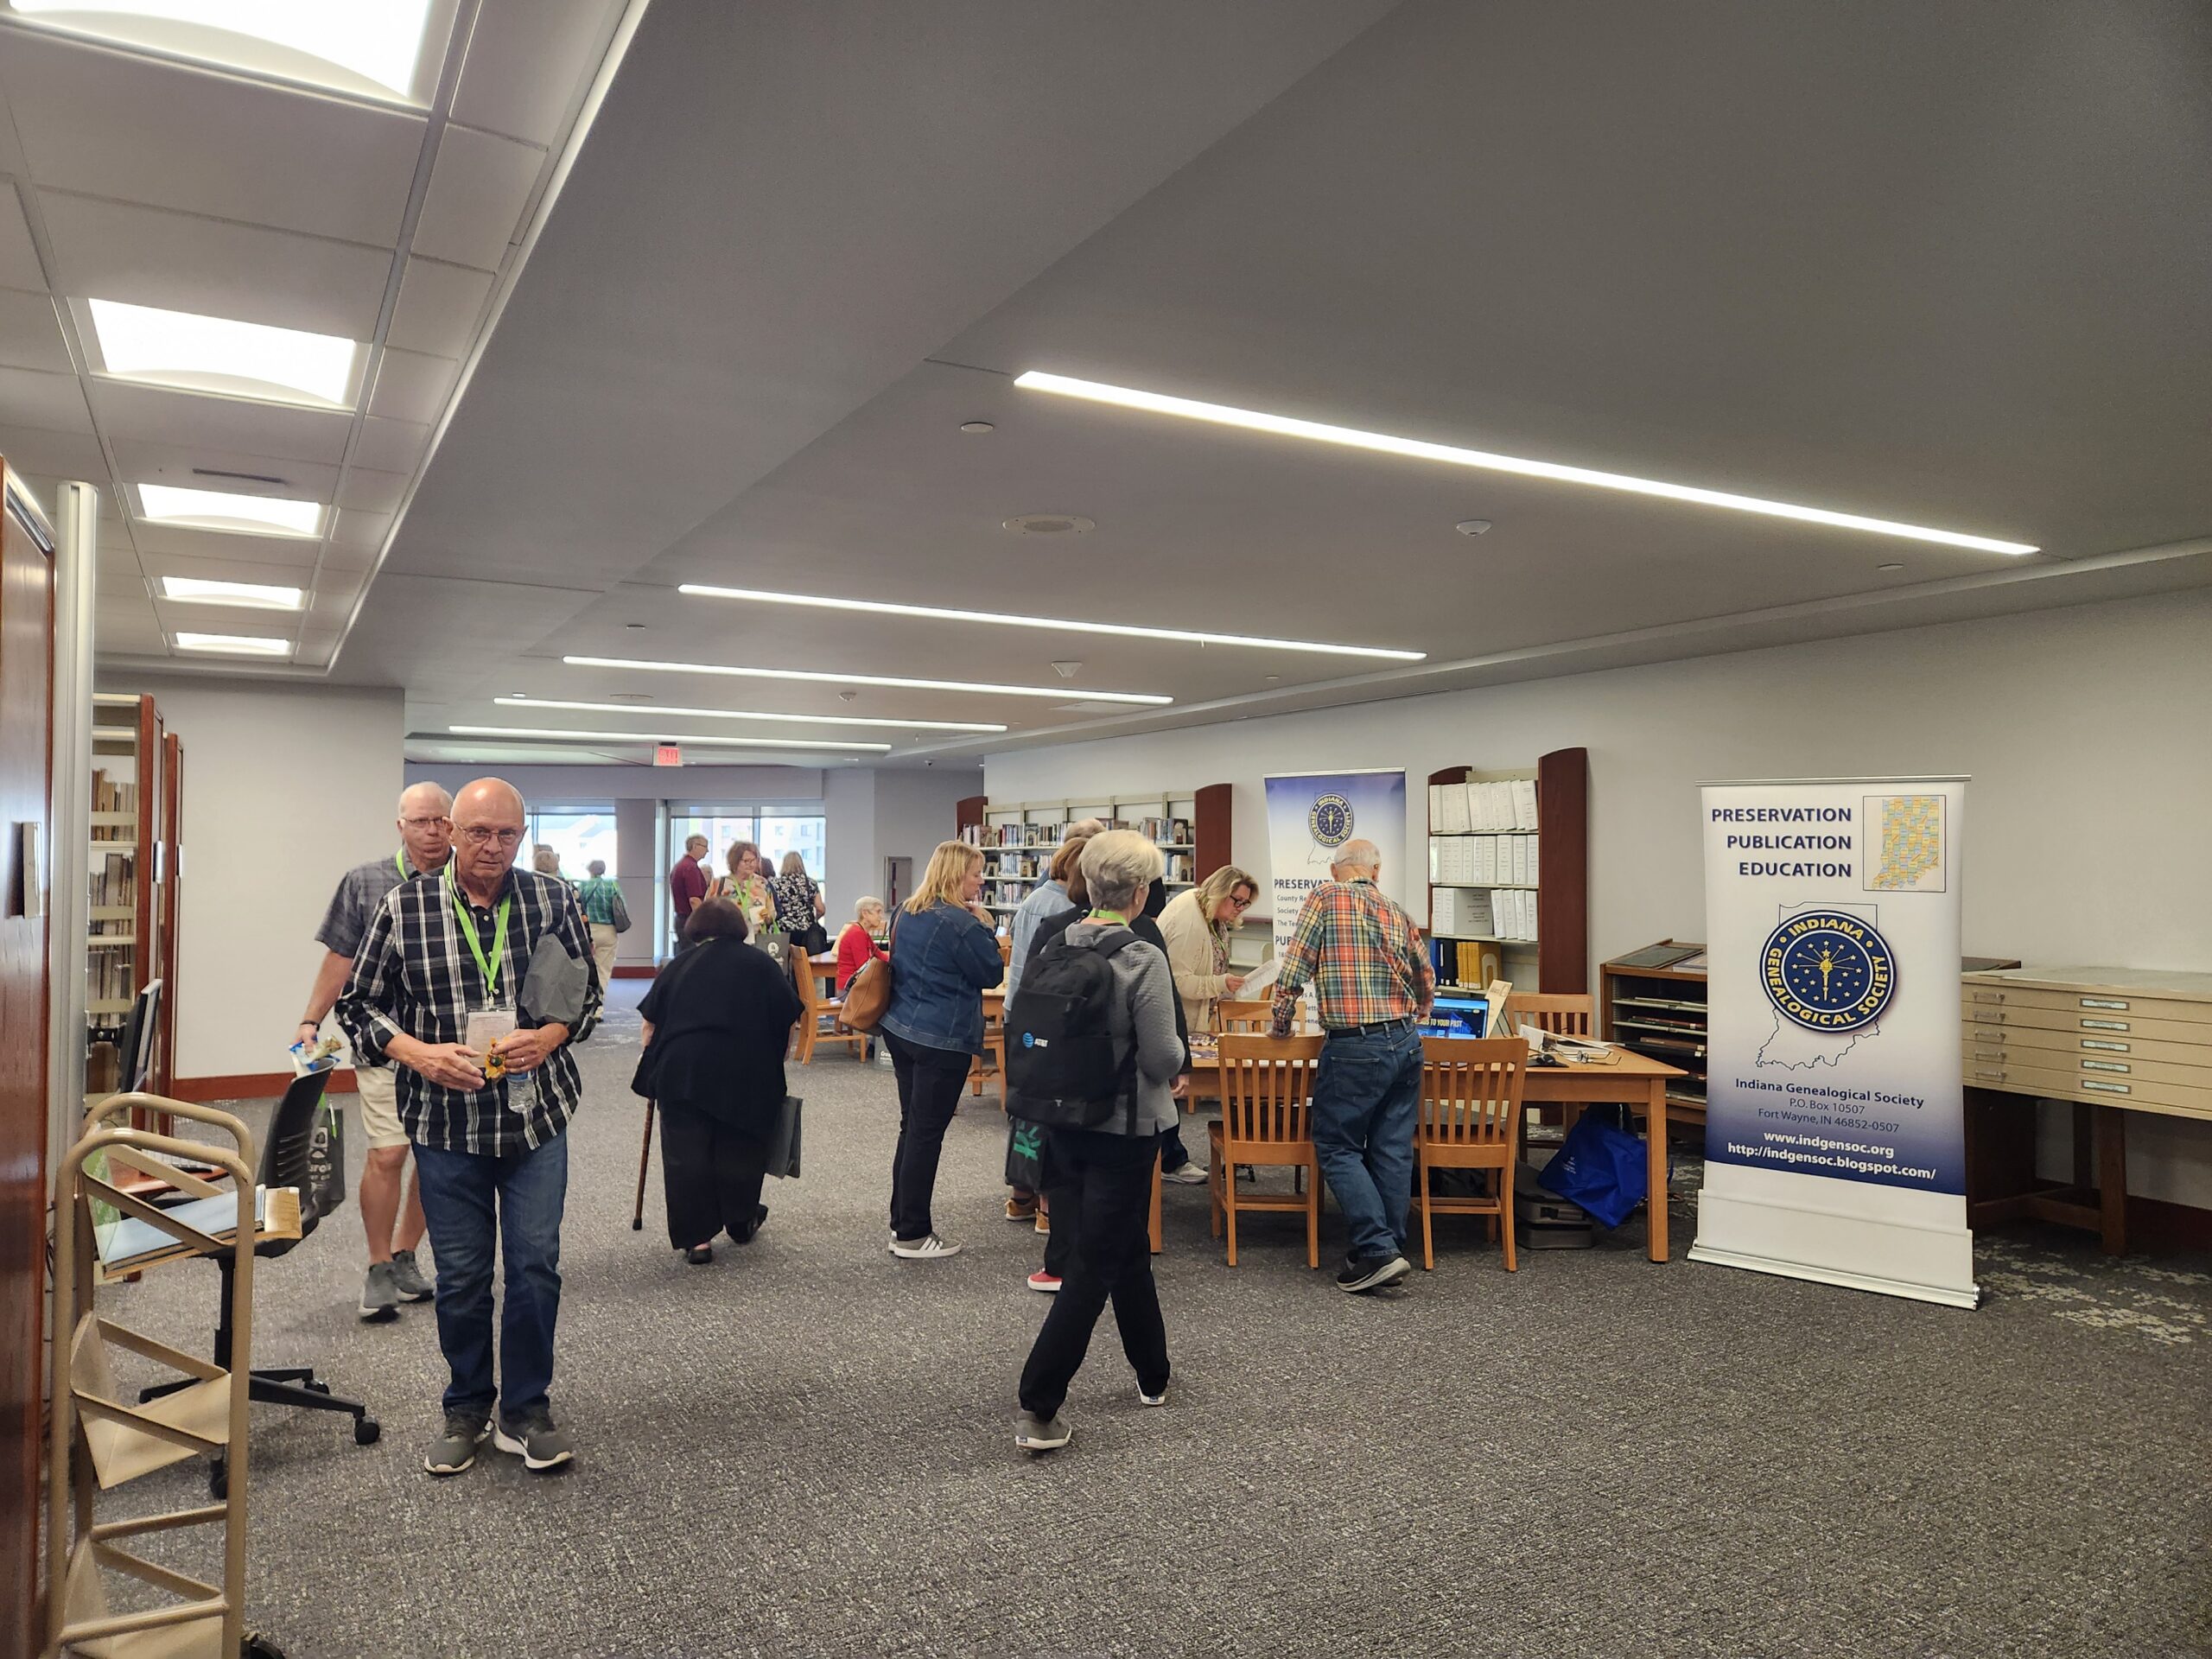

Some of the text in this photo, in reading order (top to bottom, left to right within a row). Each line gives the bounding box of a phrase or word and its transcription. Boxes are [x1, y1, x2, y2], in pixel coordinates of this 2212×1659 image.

[1318, 796, 1344, 806] INDIANA
[1712, 808, 1852, 822] PRESERVATION
[1311, 810, 1351, 843] GENEALOGICAL SOCIETY
[1727, 836, 1852, 849] PUBLICATION
[1738, 862, 1852, 877] EDUCATION
[1277, 894, 1299, 903] County
[1277, 906, 1299, 915] Society
[1788, 918, 1864, 939] INDIANA
[1768, 948, 1889, 1025] GENEALOGICAL SOCIETY
[1736, 1077, 1924, 1109] Indiana Genealogical Society
[1789, 1097, 1866, 1115] P.O. Box 10507
[1758, 1108, 1900, 1133] Fort Wayne, IN 46852-0507
[1764, 1132, 1895, 1159] www.indgensoc.org
[1727, 1141, 1936, 1180] http://indgensoc.blogspot.com/
